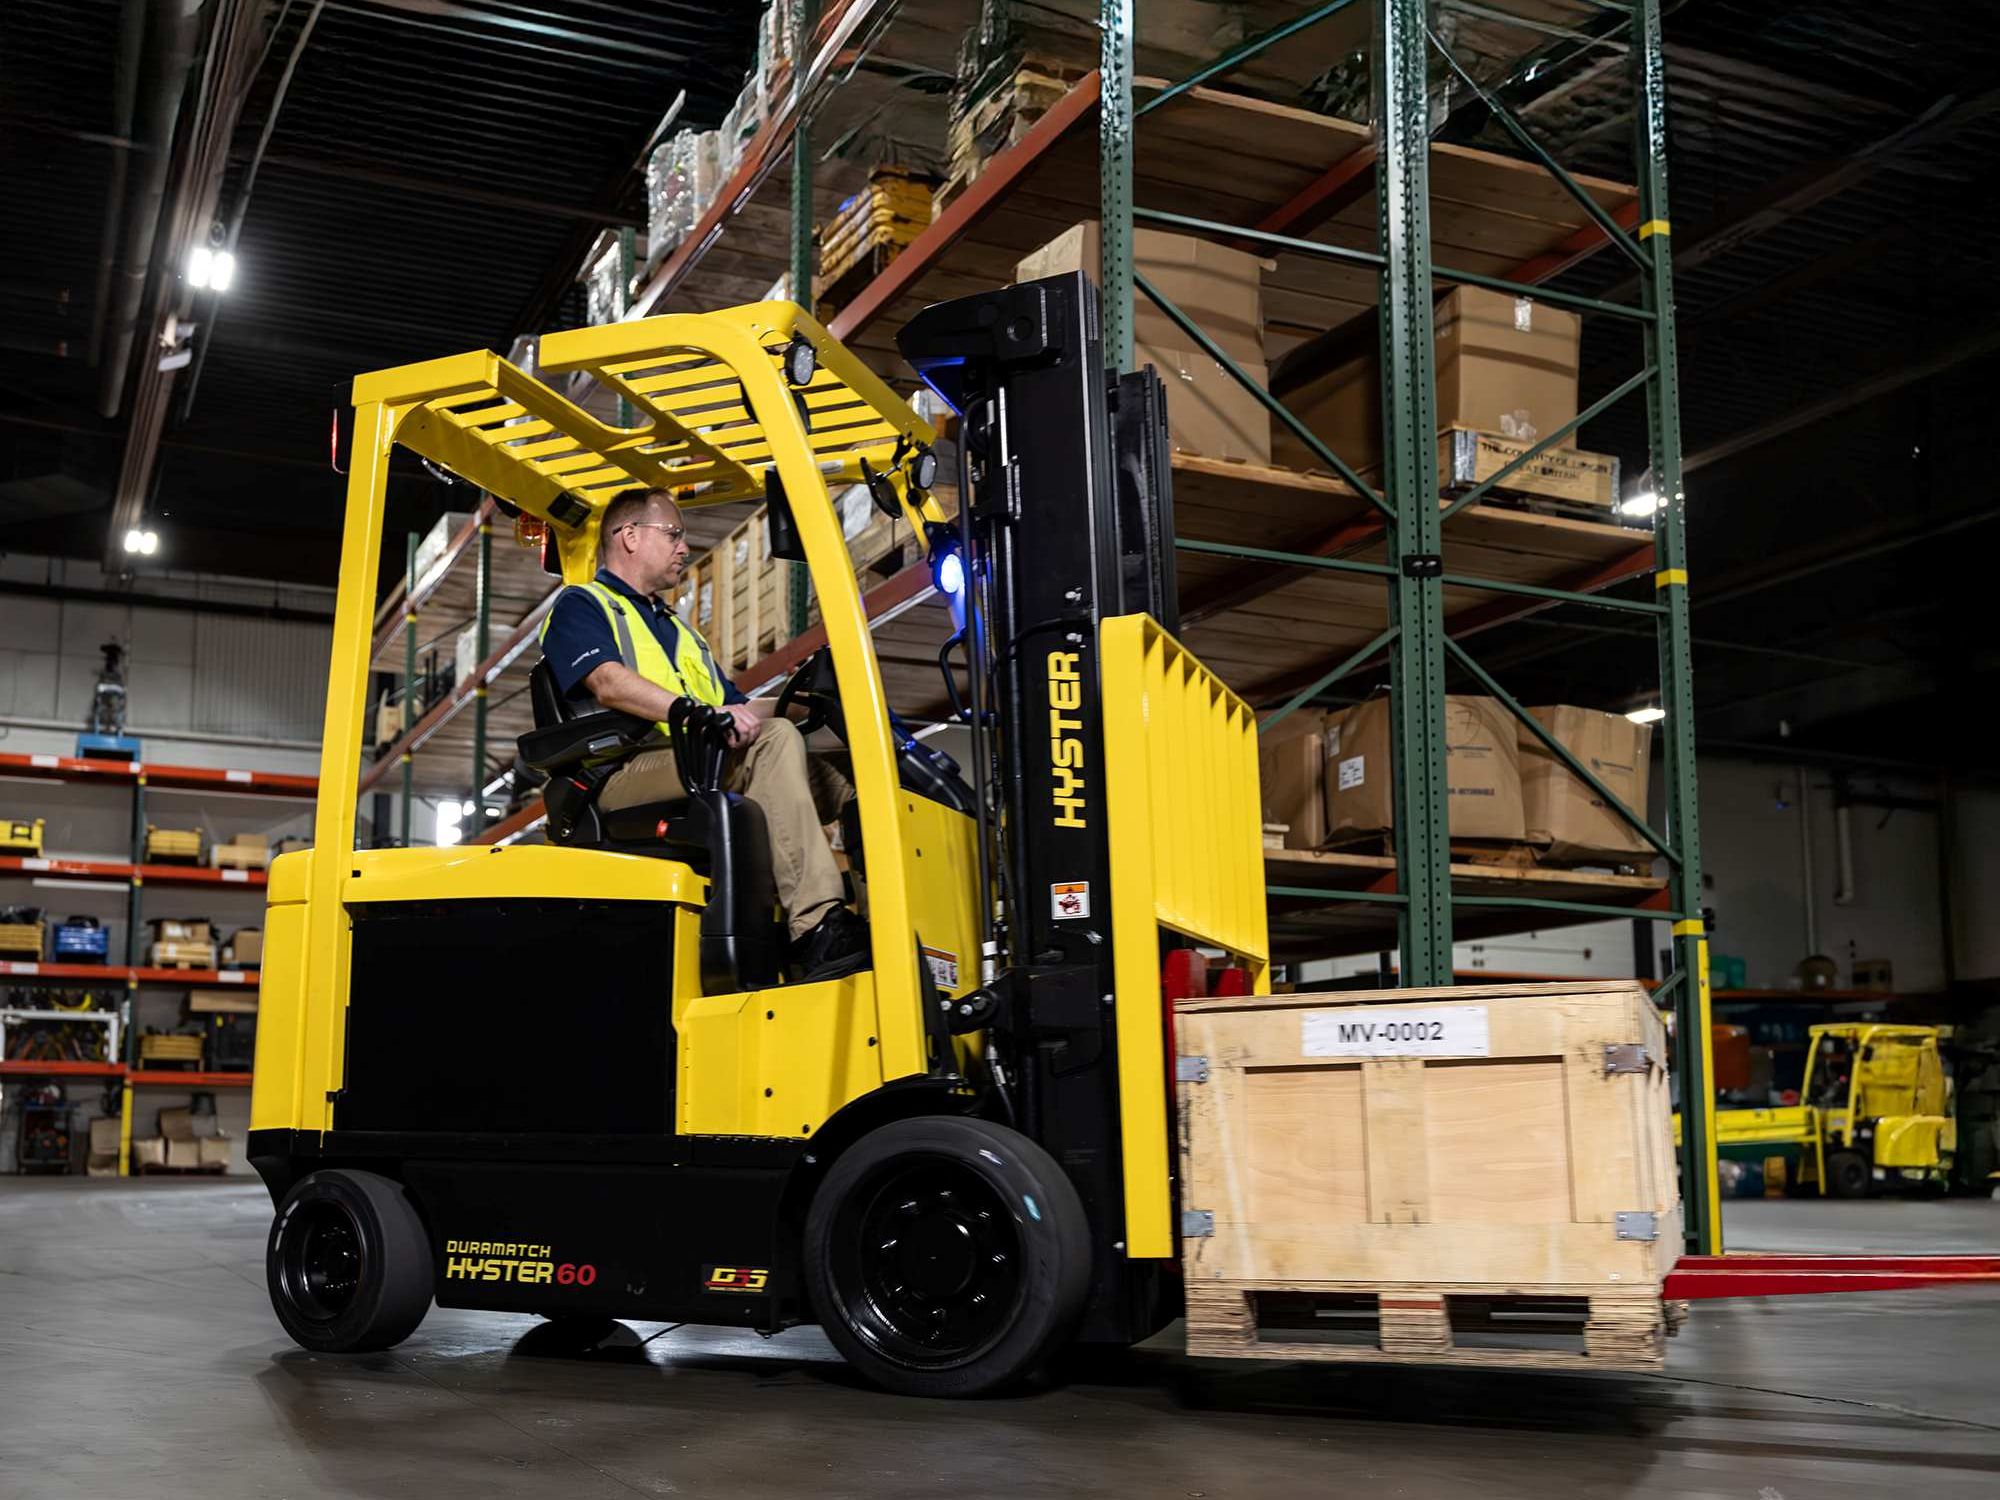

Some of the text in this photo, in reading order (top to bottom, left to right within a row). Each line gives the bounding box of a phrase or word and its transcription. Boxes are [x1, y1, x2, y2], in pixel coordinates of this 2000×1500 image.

[1047, 651, 1087, 829] HYSTER
[1338, 1021, 1445, 1043] MV-0002
[446, 1240, 551, 1258] DURAMATCH
[446, 1257, 597, 1286] HYSTER 60
